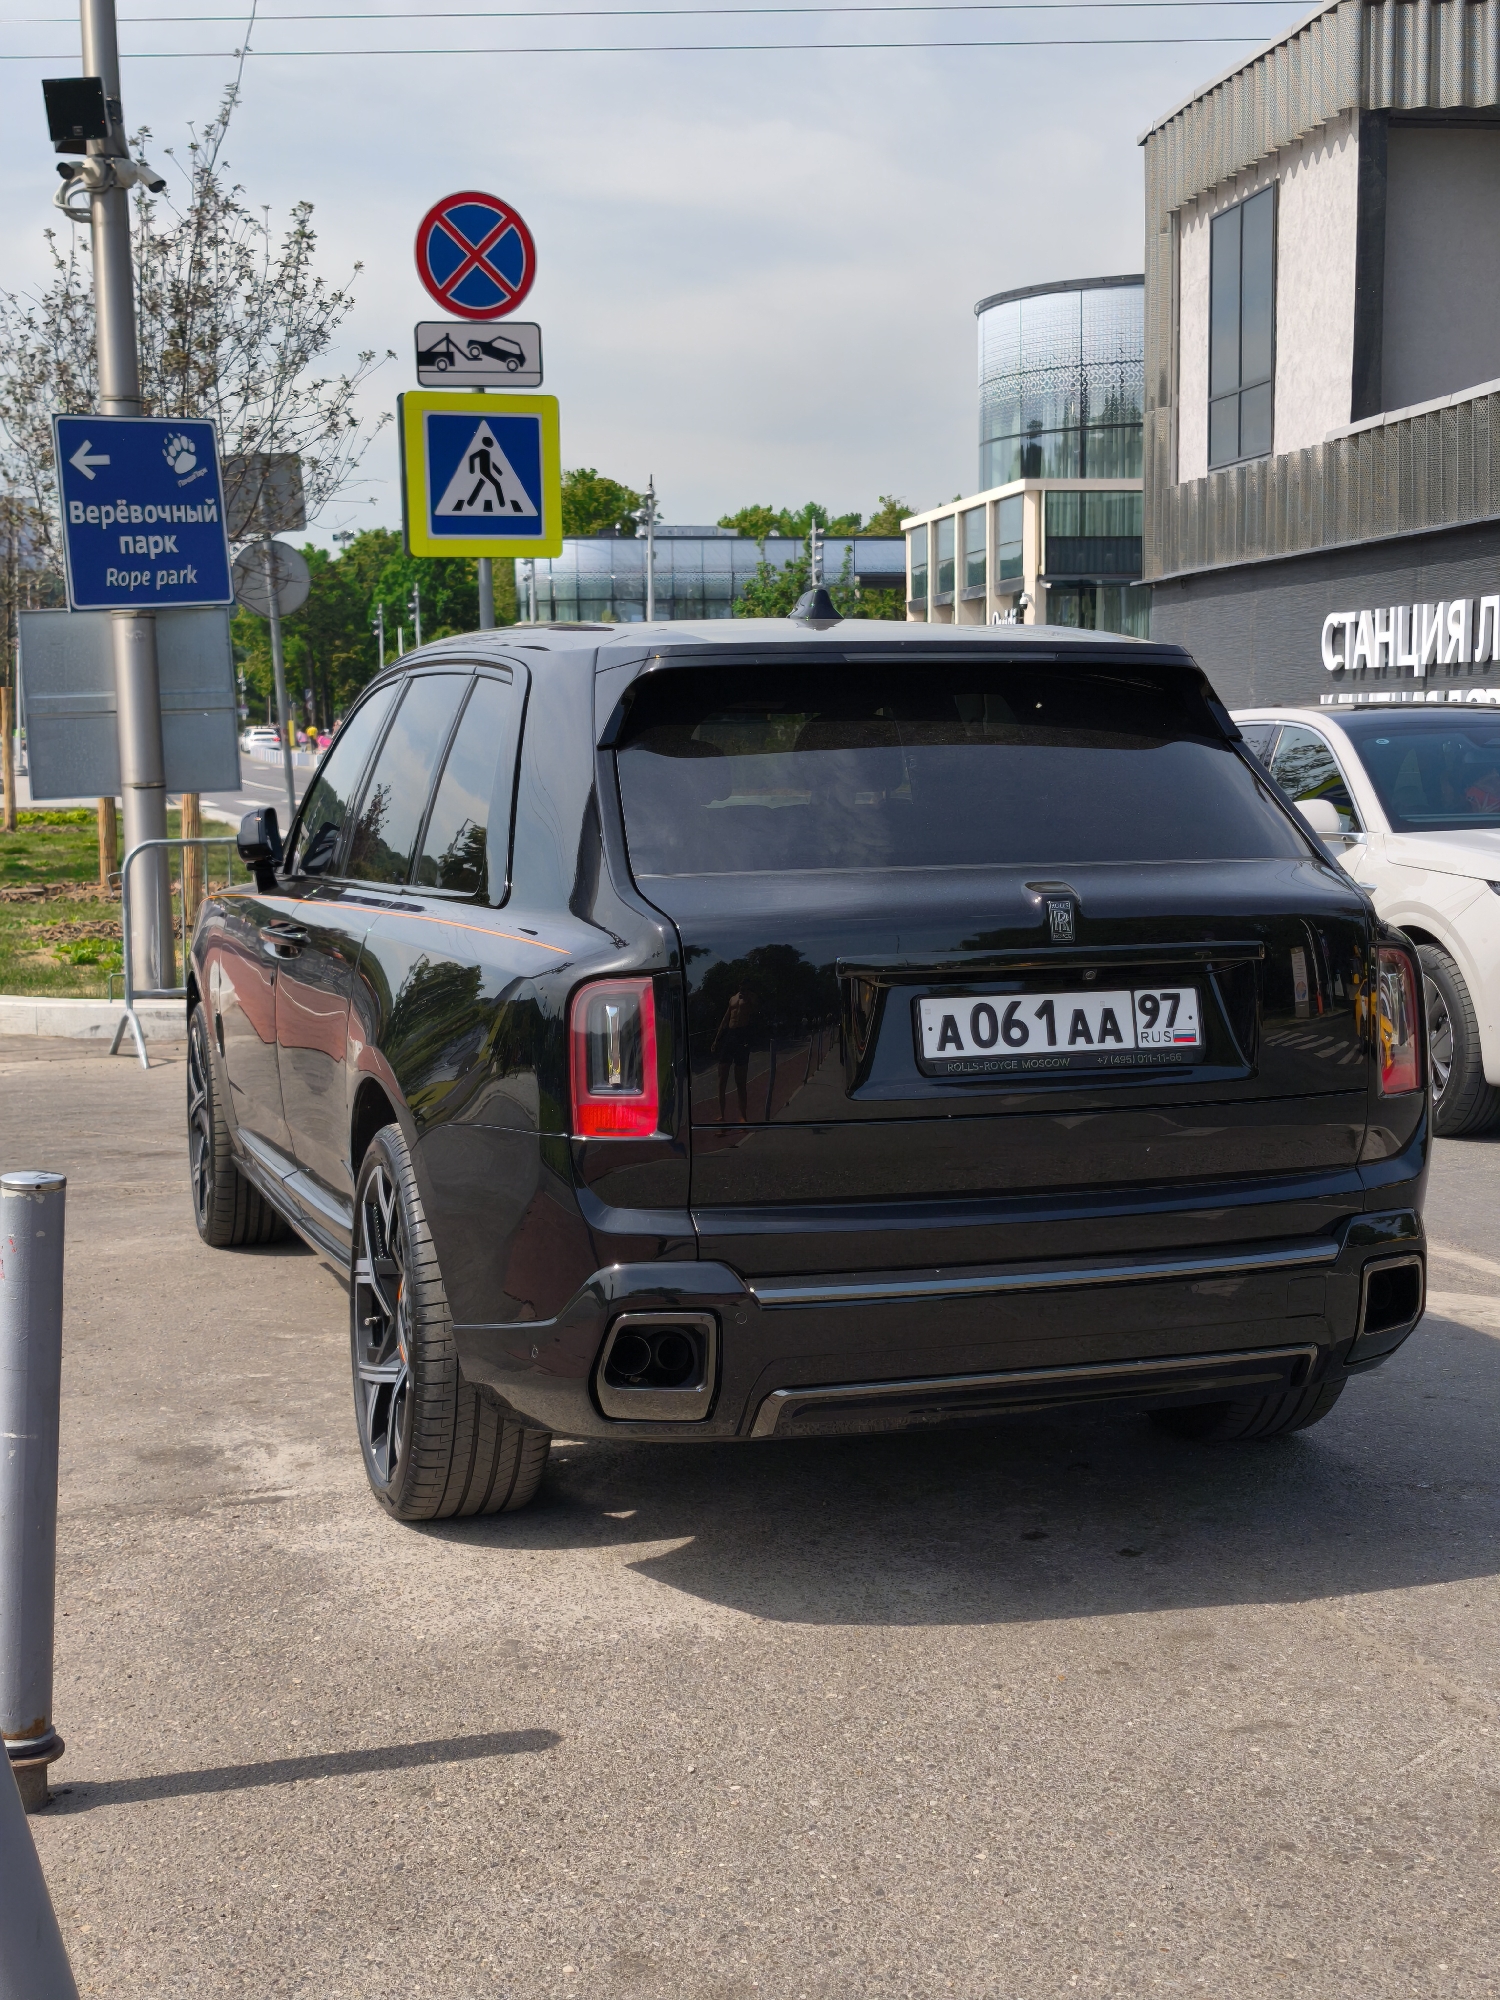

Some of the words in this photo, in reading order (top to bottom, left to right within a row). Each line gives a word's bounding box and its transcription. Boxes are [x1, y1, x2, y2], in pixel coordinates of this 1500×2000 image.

[69, 498, 218, 529] Верёвочный
[119, 534, 179, 559] парк
[106, 567, 150, 591] Rope
[156, 564, 198, 590] park
[1321, 598, 1474, 678] СТАНЦИЯ
[1137, 992, 1181, 1029] 97
[1140, 1030, 1172, 1044] RUS
[947, 1060, 1018, 1072] ROLLS-ROYCE
[1021, 1057, 1071, 1069] MOSCOW
